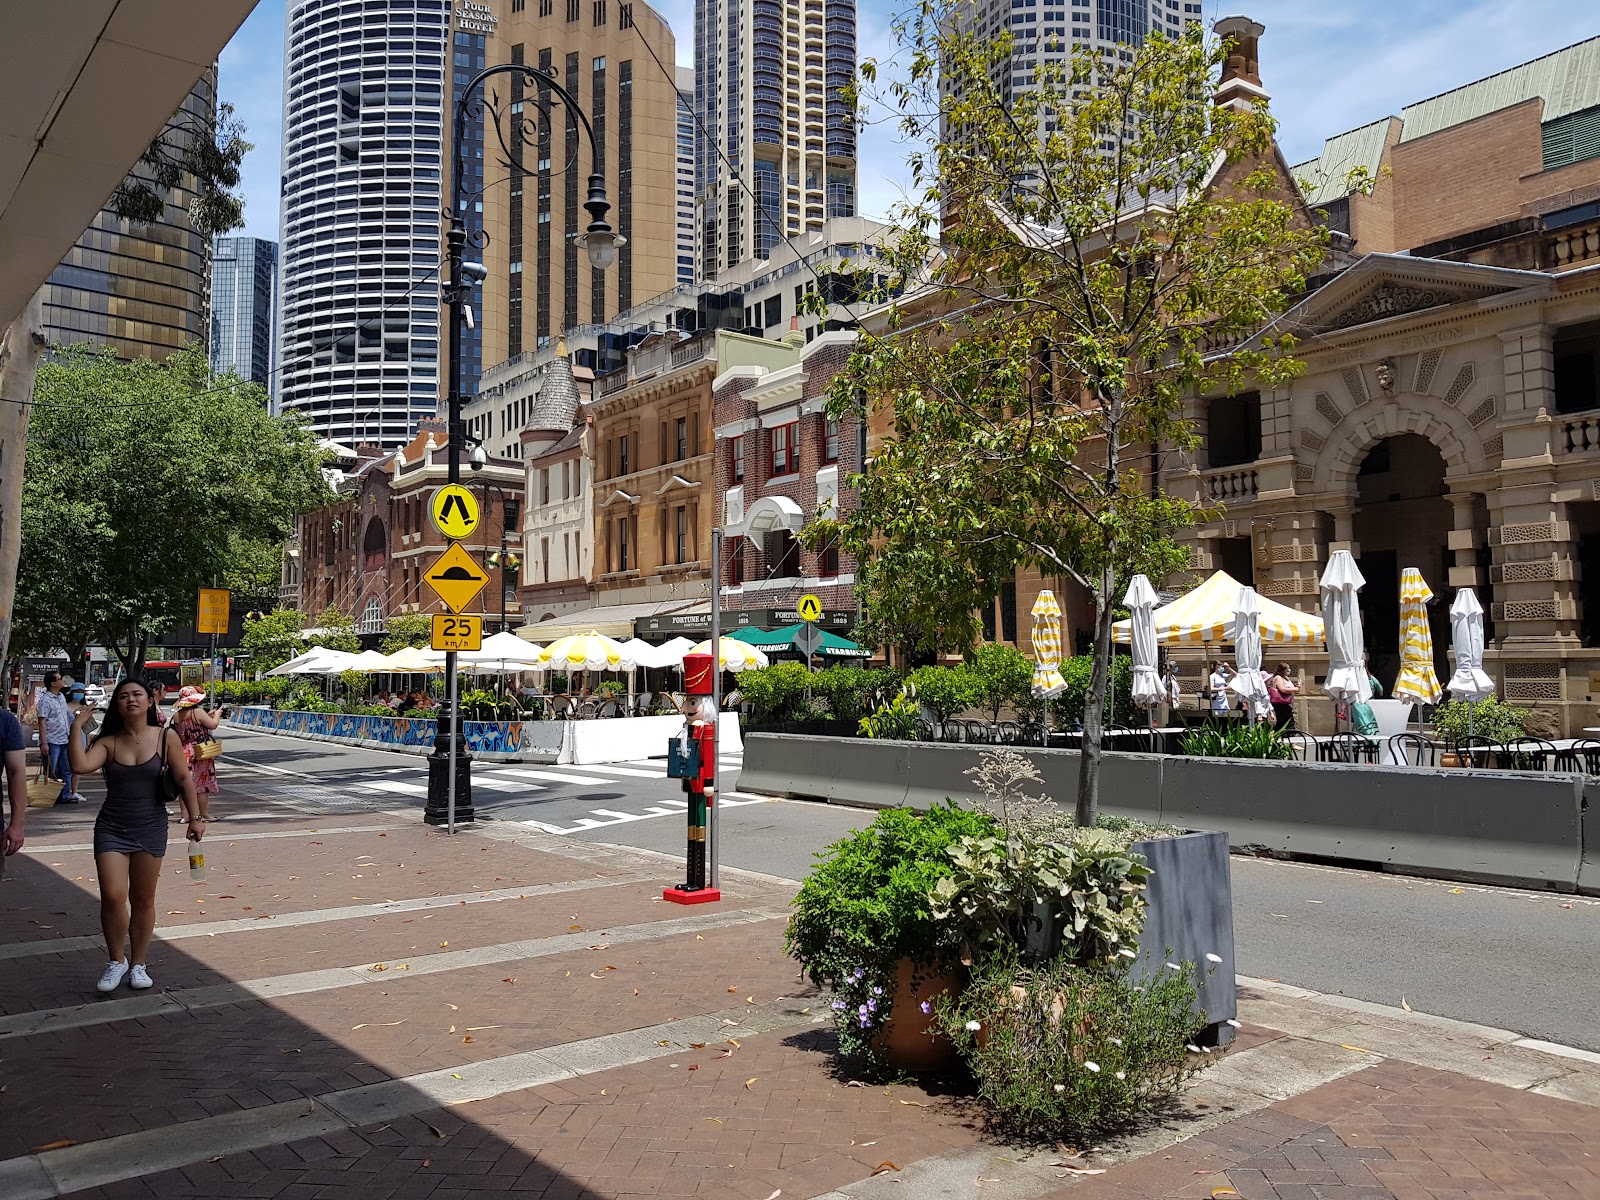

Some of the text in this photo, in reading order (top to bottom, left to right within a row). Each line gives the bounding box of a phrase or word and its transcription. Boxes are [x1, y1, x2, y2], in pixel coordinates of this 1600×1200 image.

[464, 0, 491, 12] FOUR
[456, 8, 499, 23] SEASONS
[460, 18, 494, 32] HOTEL
[1400, 327, 1464, 350] STATION
[203, 594, 226, 605] ROAD
[672, 615, 700, 624] FORTUNE
[774, 611, 801, 619] FORTUN
[200, 618, 227, 628] AHEAD
[442, 618, 472, 637] 25
[444, 639, 469, 648] km/h
